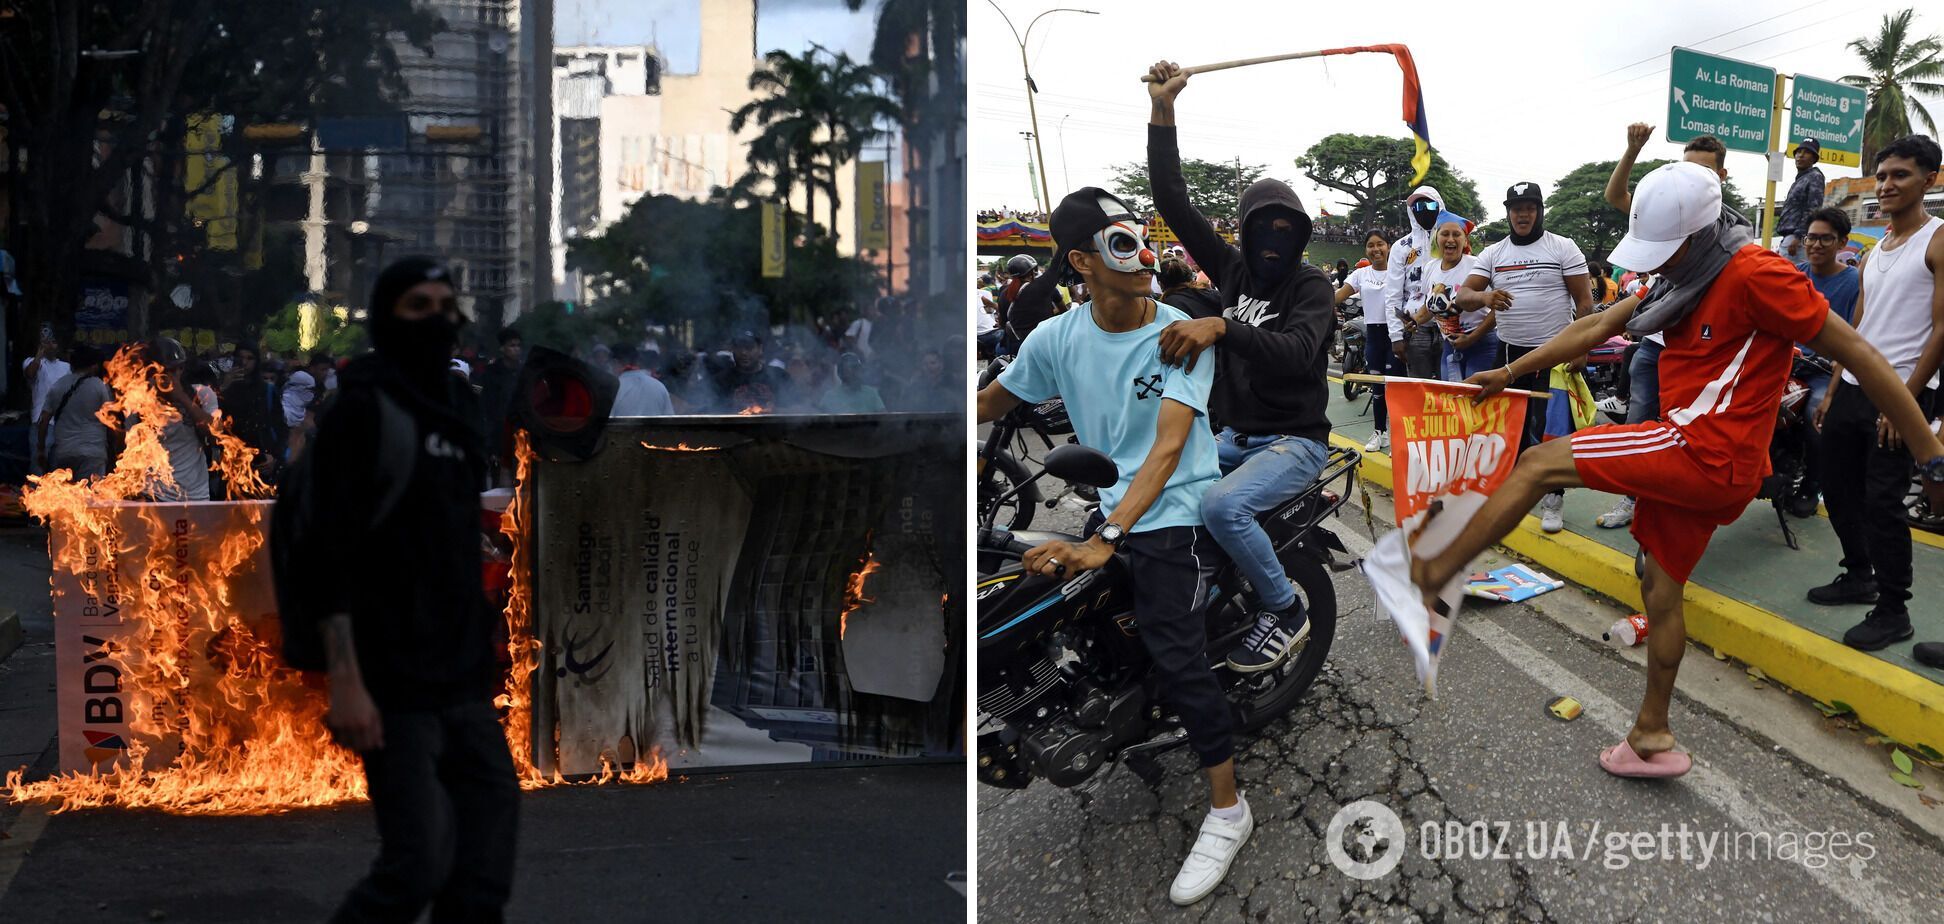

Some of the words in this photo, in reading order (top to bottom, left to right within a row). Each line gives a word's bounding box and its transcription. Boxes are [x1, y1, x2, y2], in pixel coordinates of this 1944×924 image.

[1695, 67, 1712, 82] Av.
[1714, 70, 1727, 84] La
[1729, 73, 1769, 93] Romana
[1692, 94, 1732, 112] Ricardo
[1734, 101, 1767, 119] Urriera
[1797, 88, 1837, 107] Autopista
[1680, 116, 1714, 134] Lomas
[1717, 123, 1730, 136] de
[1732, 125, 1765, 141] Funval
[1795, 106, 1812, 121] San
[1813, 110, 1840, 126] Carlos
[1793, 123, 1848, 144] Barquisimeto
[1422, 391, 1439, 413] EL
[1402, 415, 1418, 439] DE
[1420, 414, 1460, 438] JULIO
[1407, 433, 1506, 497] MADRO
[171, 519, 189, 569] venta
[642, 517, 661, 594] calidad
[102, 524, 121, 617] Venezuea
[574, 521, 597, 615] Santiago
[682, 540, 700, 618] alcance
[593, 589, 611, 613] de
[643, 599, 658, 626] de
[662, 531, 681, 673] internacional
[684, 624, 699, 645] tu
[643, 632, 661, 689] Salud
[687, 651, 699, 663] a
[82, 634, 123, 724] BDV
